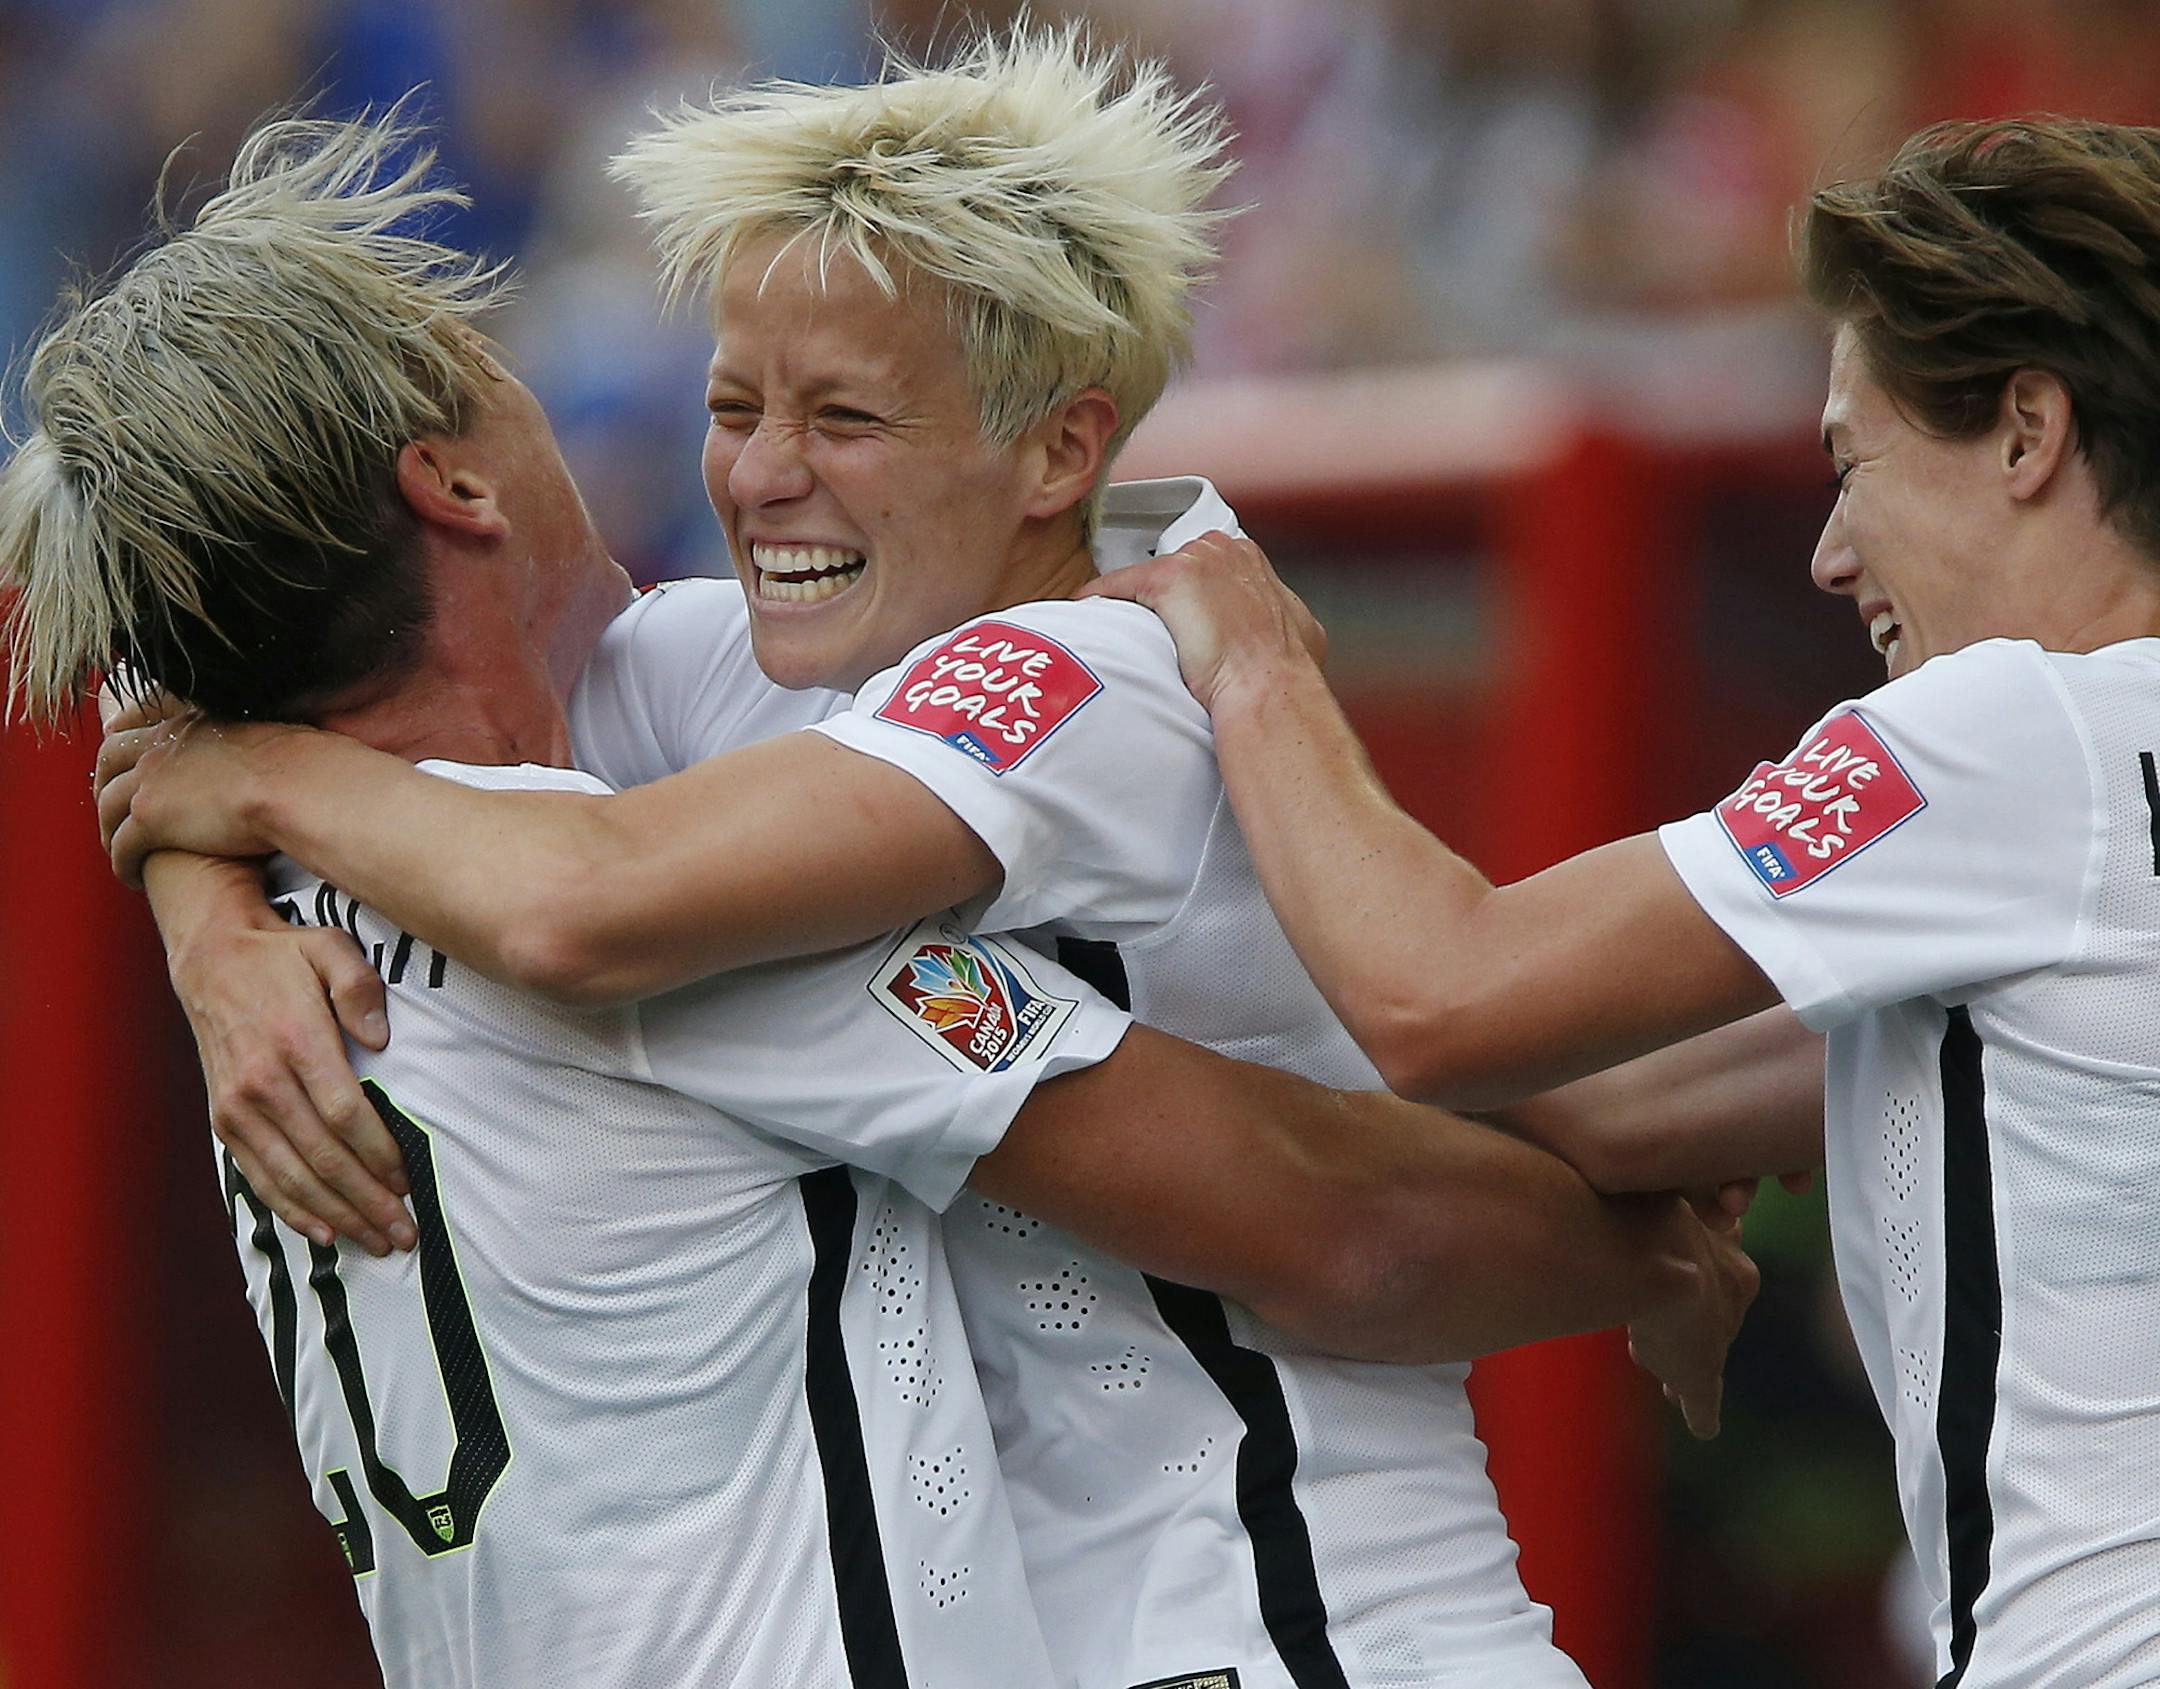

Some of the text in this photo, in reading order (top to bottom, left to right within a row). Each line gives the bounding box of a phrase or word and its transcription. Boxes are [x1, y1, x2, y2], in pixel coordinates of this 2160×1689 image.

[953, 636, 1053, 677] LIVE
[931, 655, 1043, 718] YOUR
[905, 680, 1037, 745] GOALS
[956, 734, 989, 761] FIFA
[1802, 738, 1881, 790] LIVE
[1734, 780, 1845, 859] GOALS
[1756, 846, 1785, 879] FIFA
[1017, 1000, 1045, 1026] FIFA
[981, 1026, 1008, 1062] 2015
